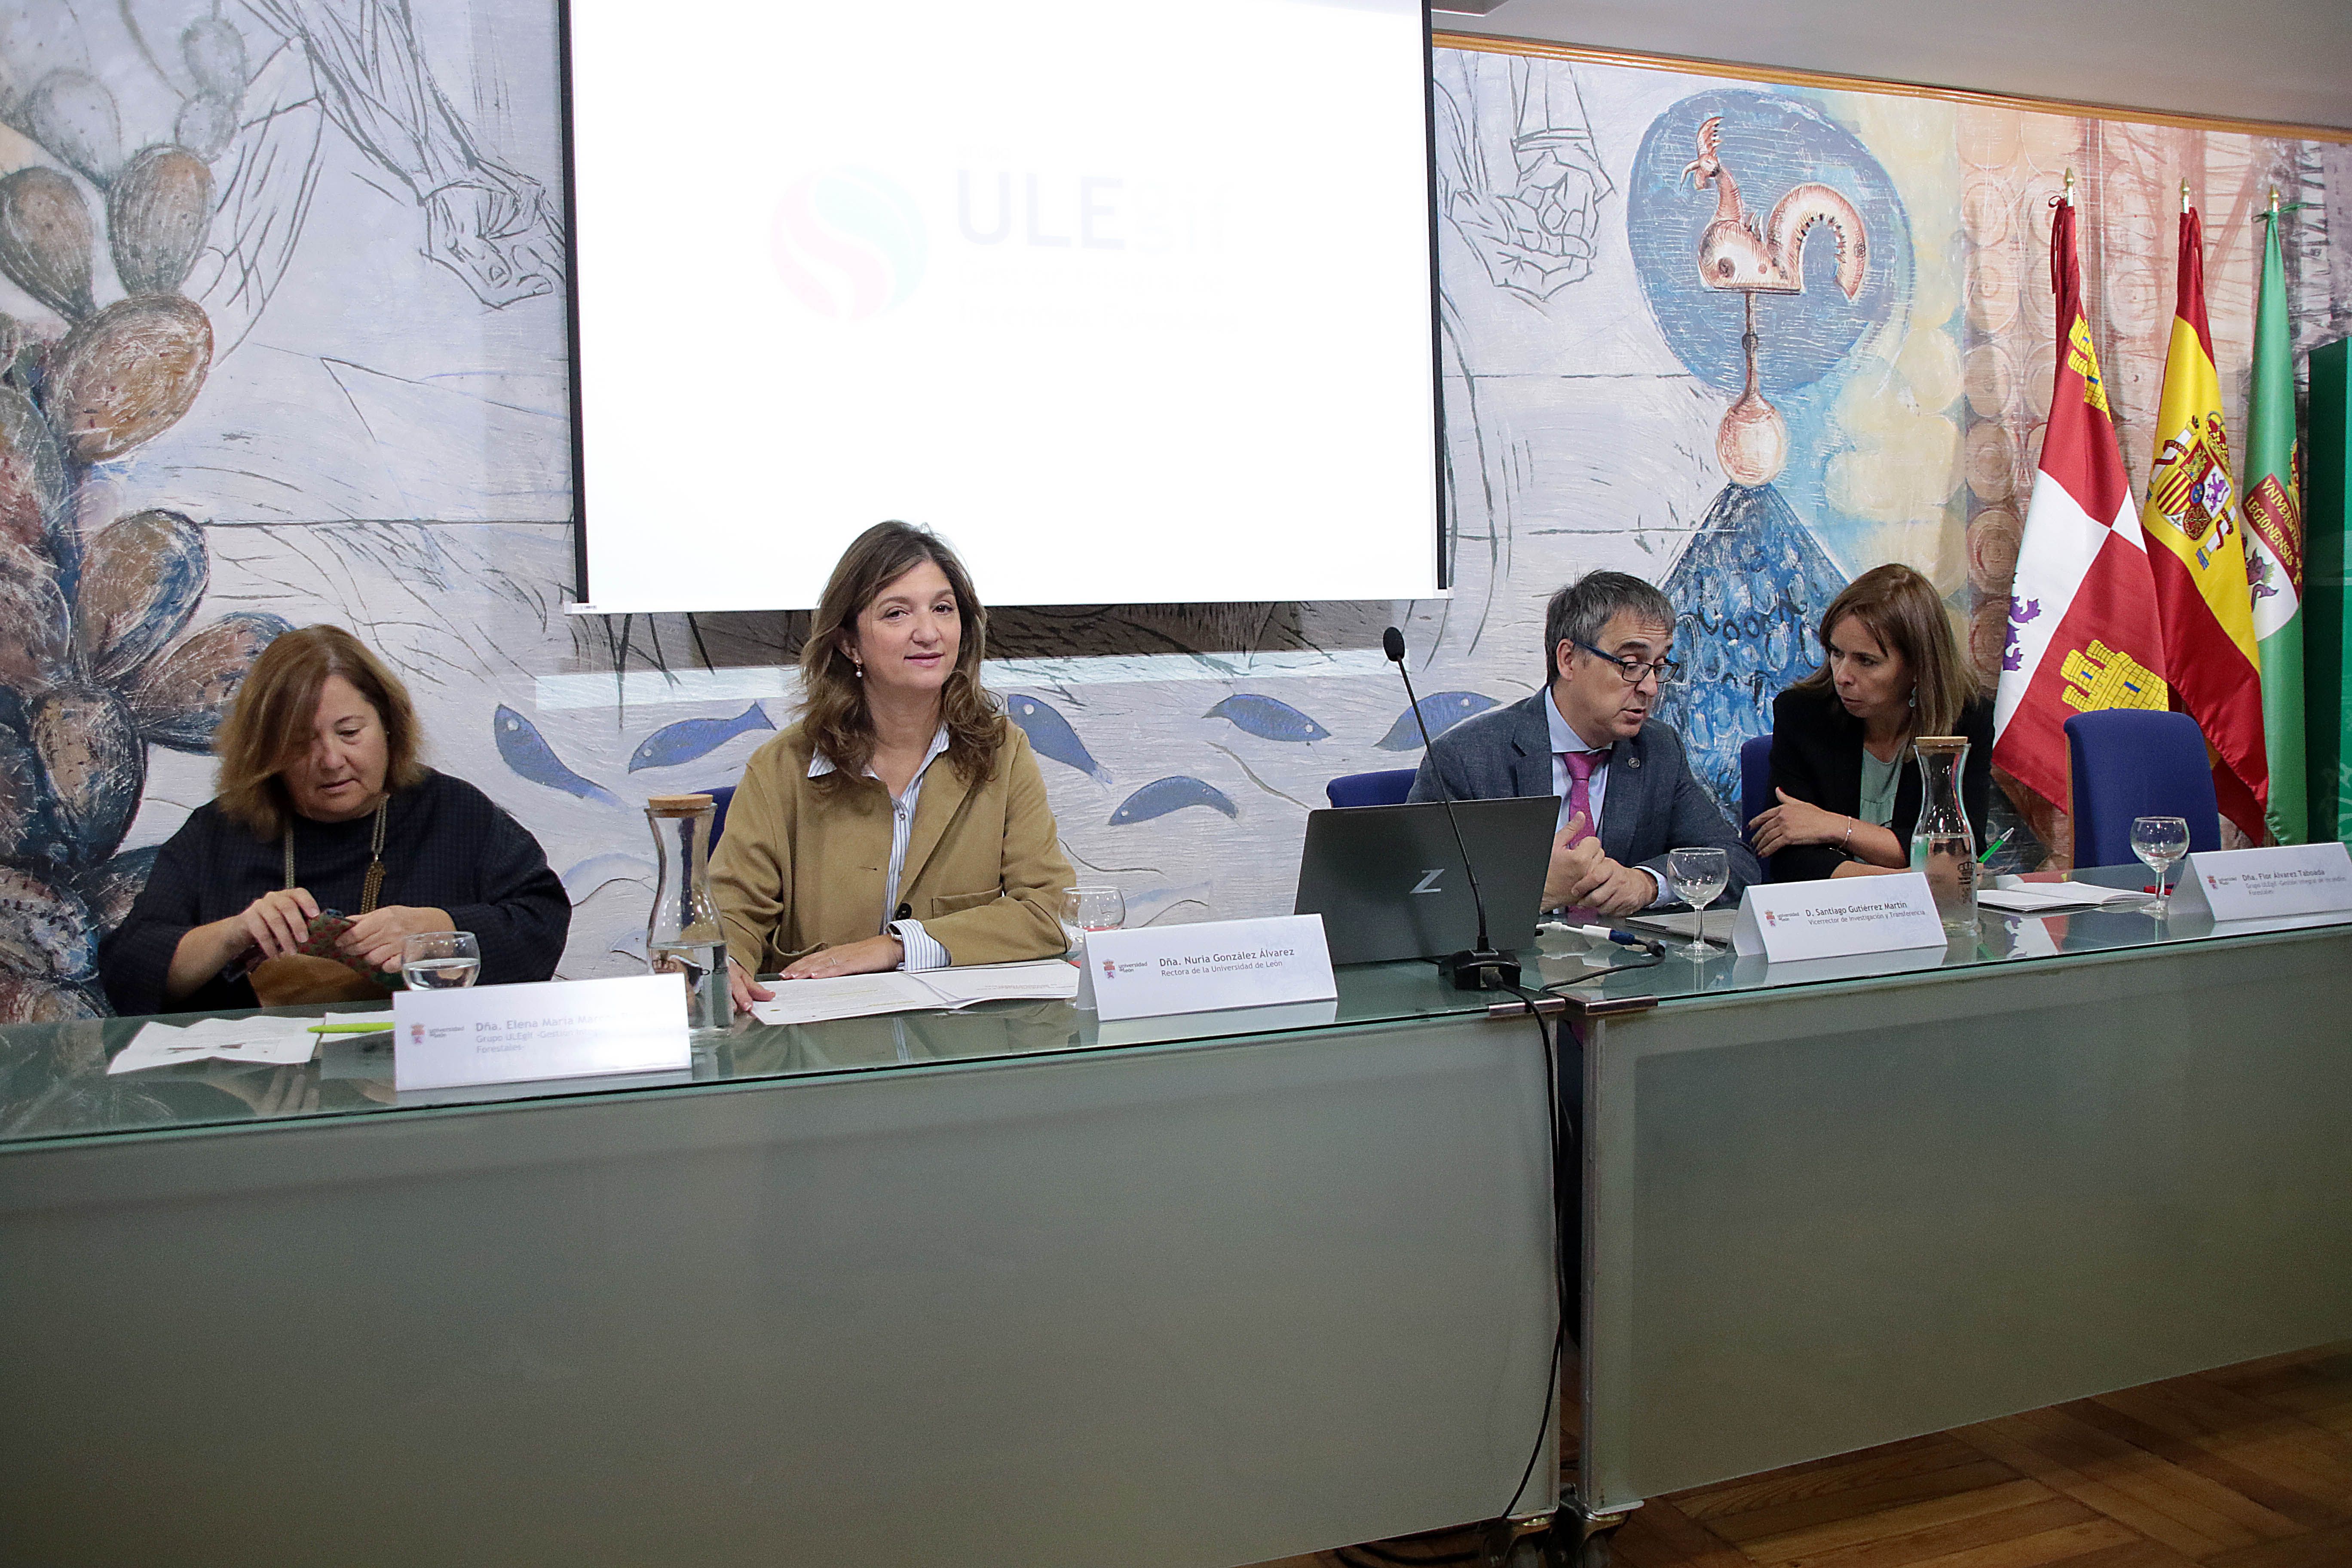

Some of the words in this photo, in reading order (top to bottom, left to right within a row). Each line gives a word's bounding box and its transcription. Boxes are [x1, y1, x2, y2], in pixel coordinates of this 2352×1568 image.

[2245, 496, 2294, 566] LEGIONENSIS
[1409, 869, 1445, 894] Z
[1816, 907, 1847, 917] Santiago
[1848, 904, 1883, 913] Gutiérrez
[1884, 901, 1907, 910] Martín
[1849, 912, 1884, 922] Investigación
[1889, 910, 1926, 918] Transferencia
[1160, 958, 1182, 967] Dña.
[1184, 955, 1210, 965] Nuria
[1213, 951, 1257, 962] González
[1260, 948, 1295, 958] Álvarez
[1211, 962, 1253, 972] Universidad
[476, 1022, 502, 1032] Dña.
[506, 1020, 538, 1029] Elena
[476, 1035, 503, 1043] Grupo
